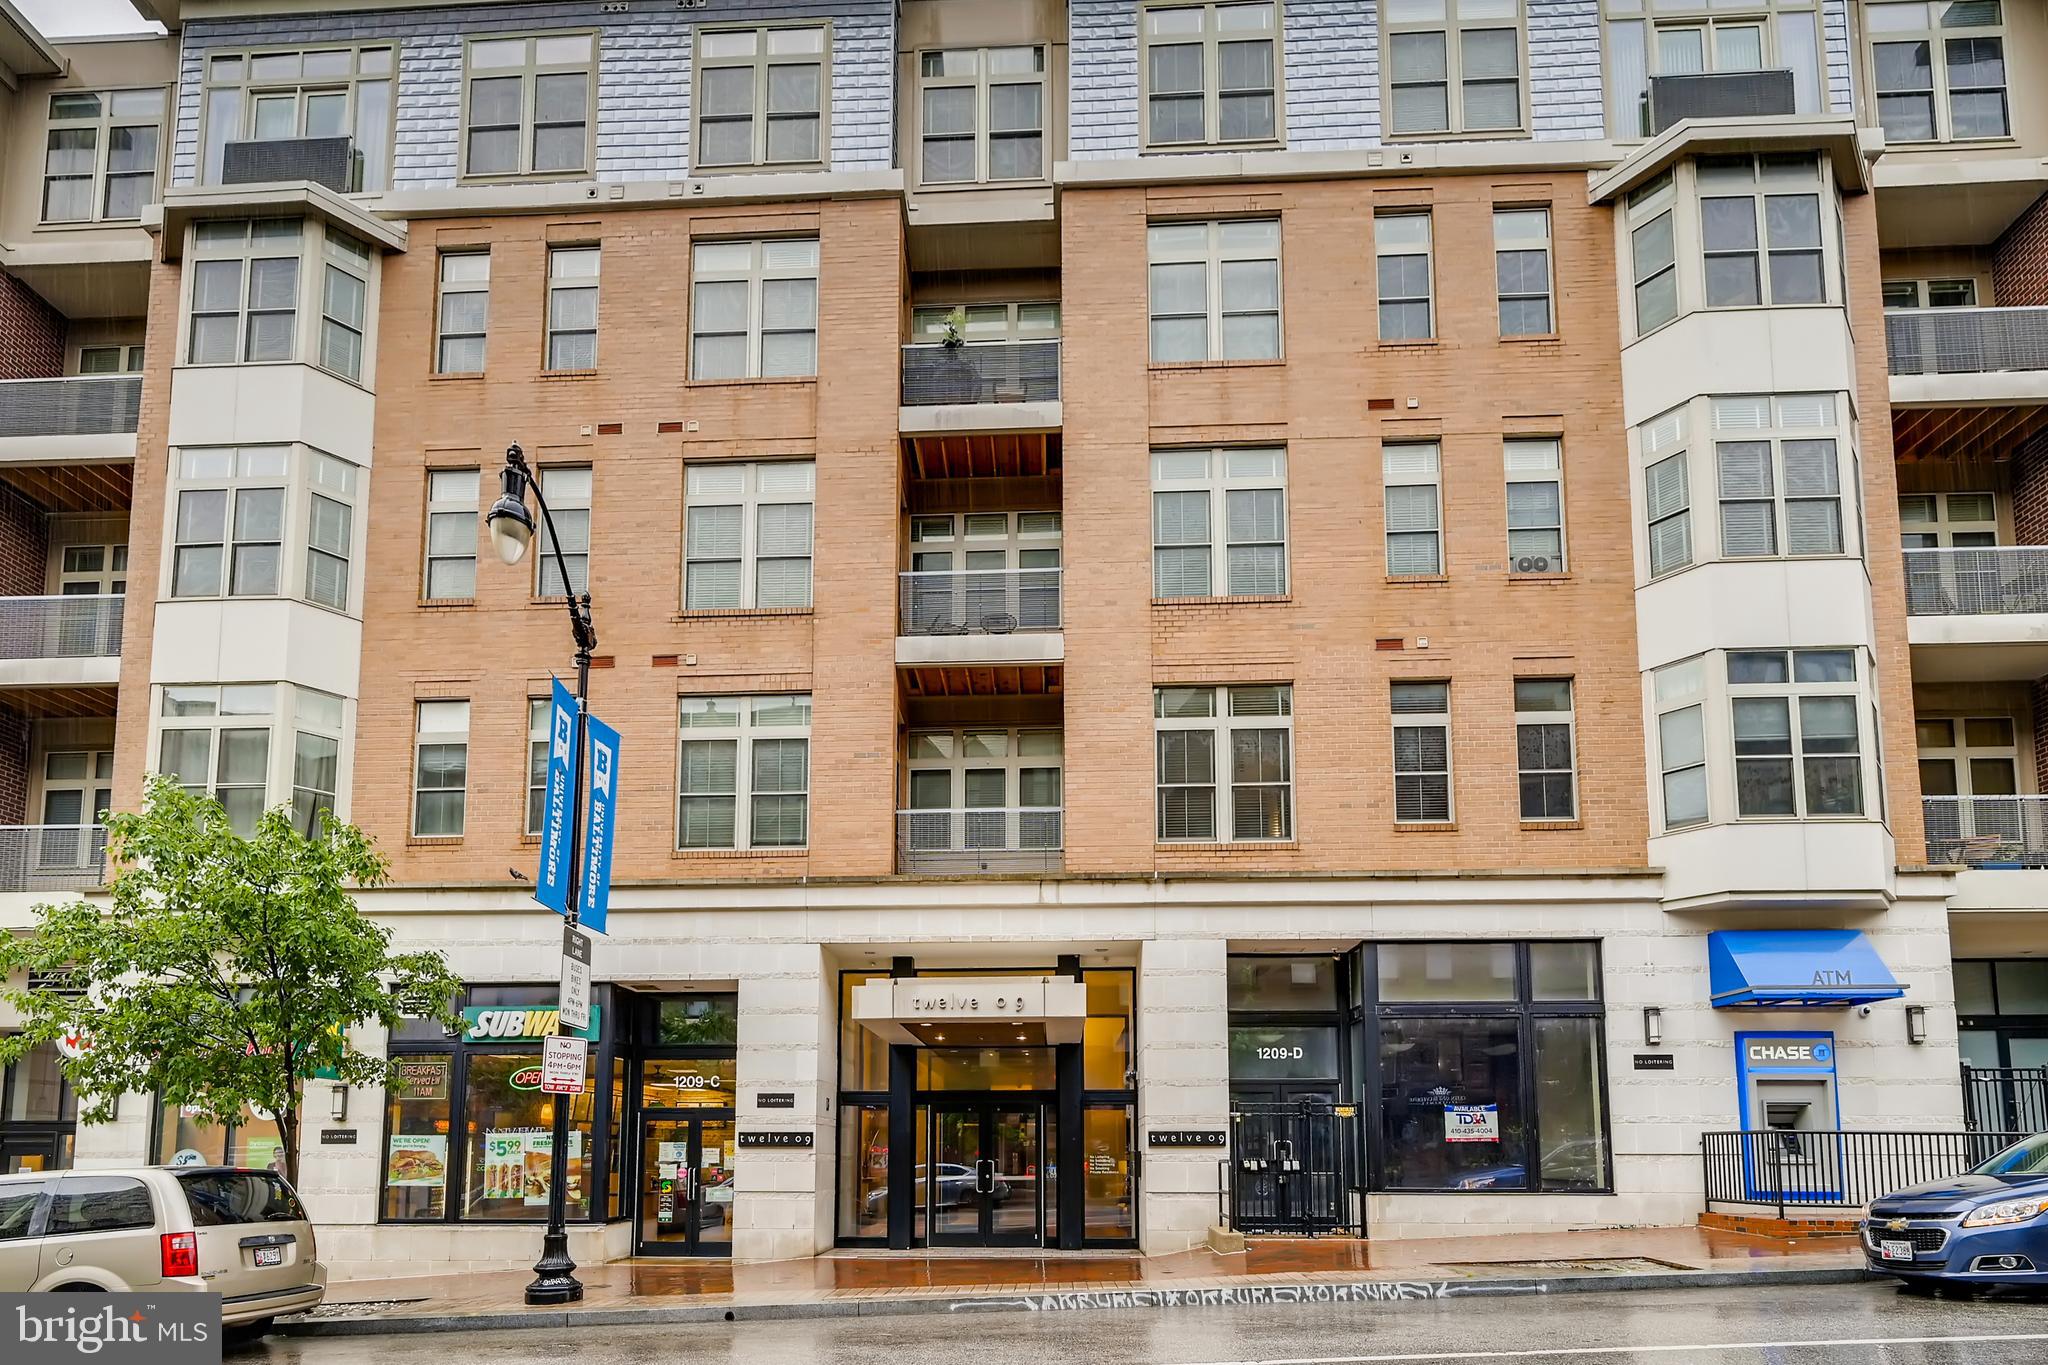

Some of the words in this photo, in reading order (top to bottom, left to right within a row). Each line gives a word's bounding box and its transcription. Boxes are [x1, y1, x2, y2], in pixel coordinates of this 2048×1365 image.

[546, 769, 560, 888] BALTIMORE
[587, 799, 602, 909] BALTIMORE
[572, 946, 582, 959] LANE
[1812, 970, 1852, 985] ATM
[913, 991, 979, 1010] twelve
[469, 1010, 560, 1038] SUBWA
[548, 1052, 582, 1060] STOPPING
[1256, 1047, 1303, 1059] 1209-D
[1750, 1046, 1811, 1060] CHASE
[401, 1065, 446, 1076] BREAKFAST
[406, 1076, 430, 1085] Served
[673, 1075, 720, 1088] 1209-C
[413, 1087, 433, 1096] 11AM
[740, 1133, 788, 1143] twelve
[1151, 1132, 1202, 1143] twelve
